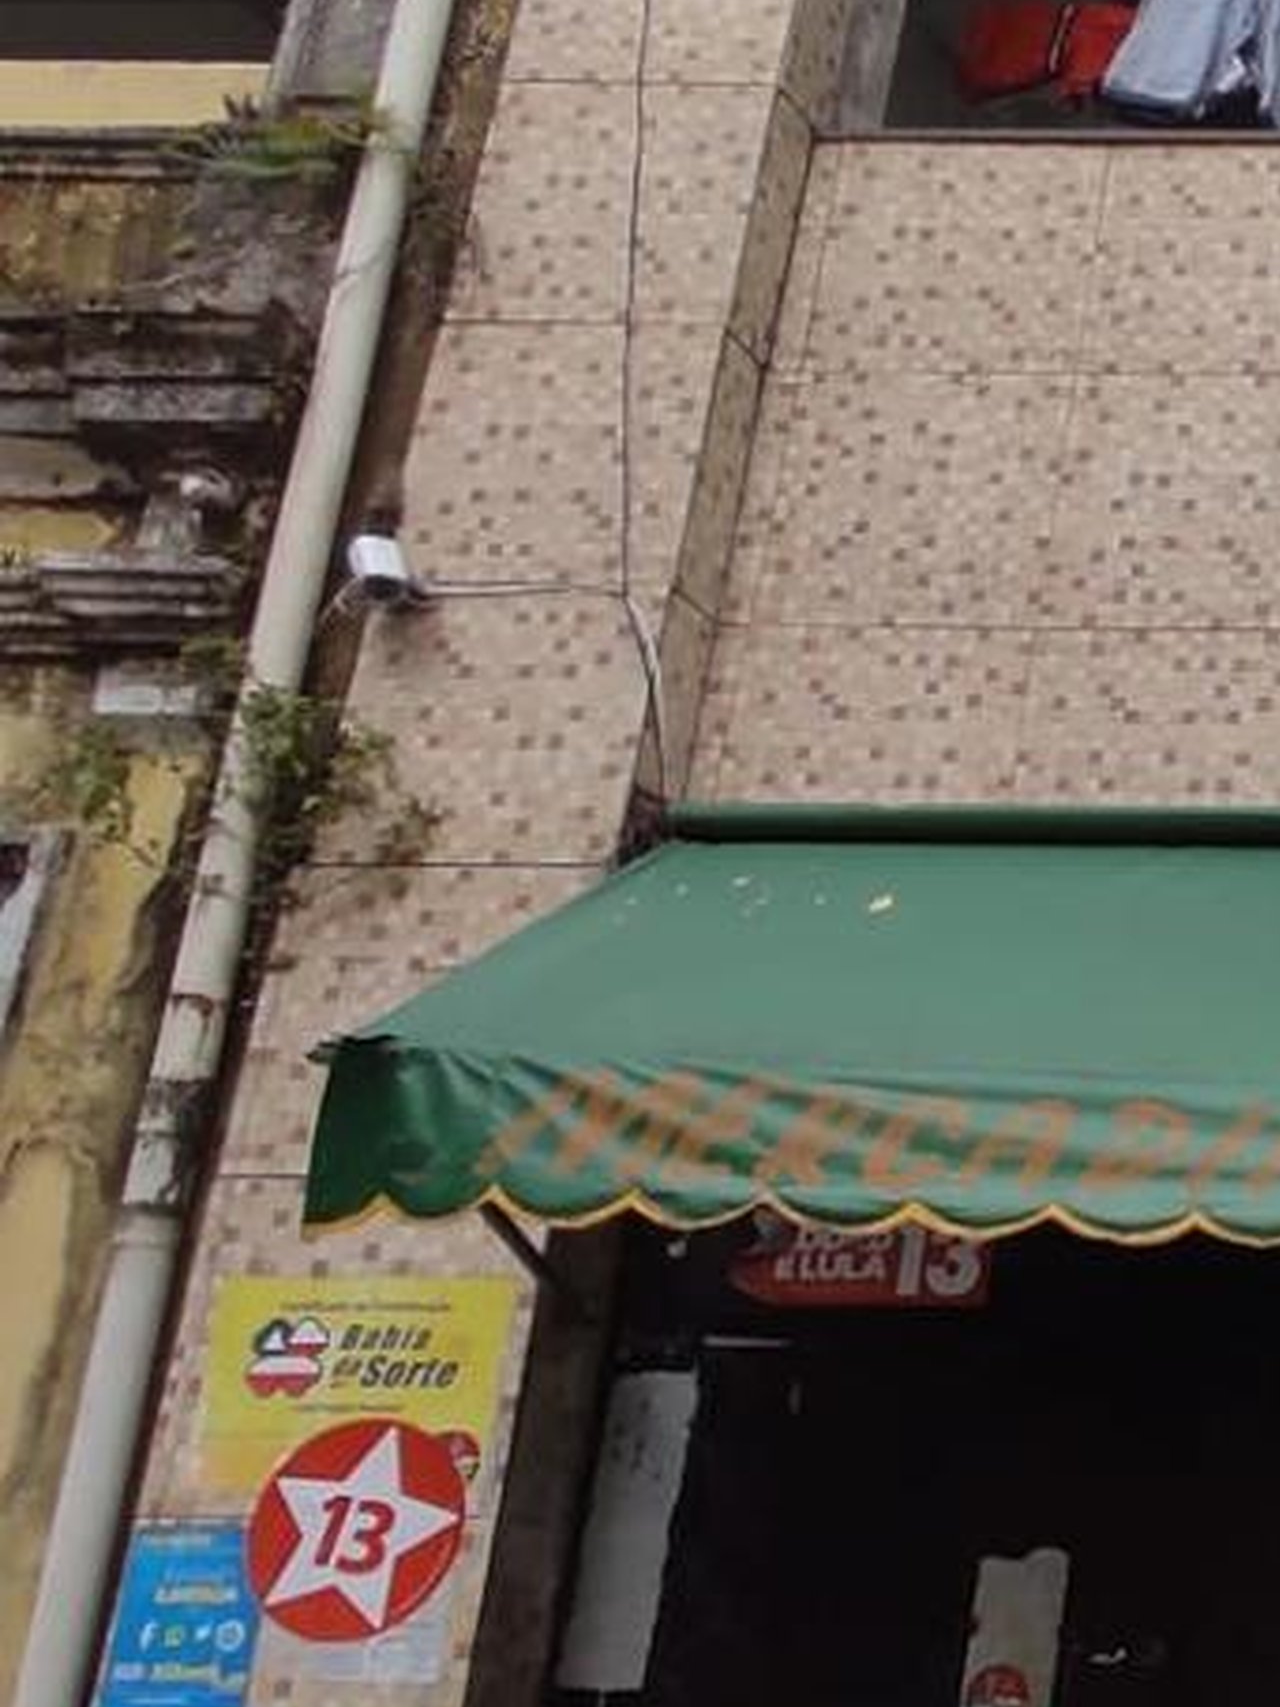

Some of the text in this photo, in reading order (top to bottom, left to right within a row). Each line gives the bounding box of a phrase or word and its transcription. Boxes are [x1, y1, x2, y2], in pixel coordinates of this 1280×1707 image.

[800, 1251, 887, 1282] LULA
[896, 1226, 981, 1296] 13
[341, 1322, 433, 1351] Bahia
[360, 1354, 459, 1390] Sorte
[314, 1494, 397, 1575] 13
